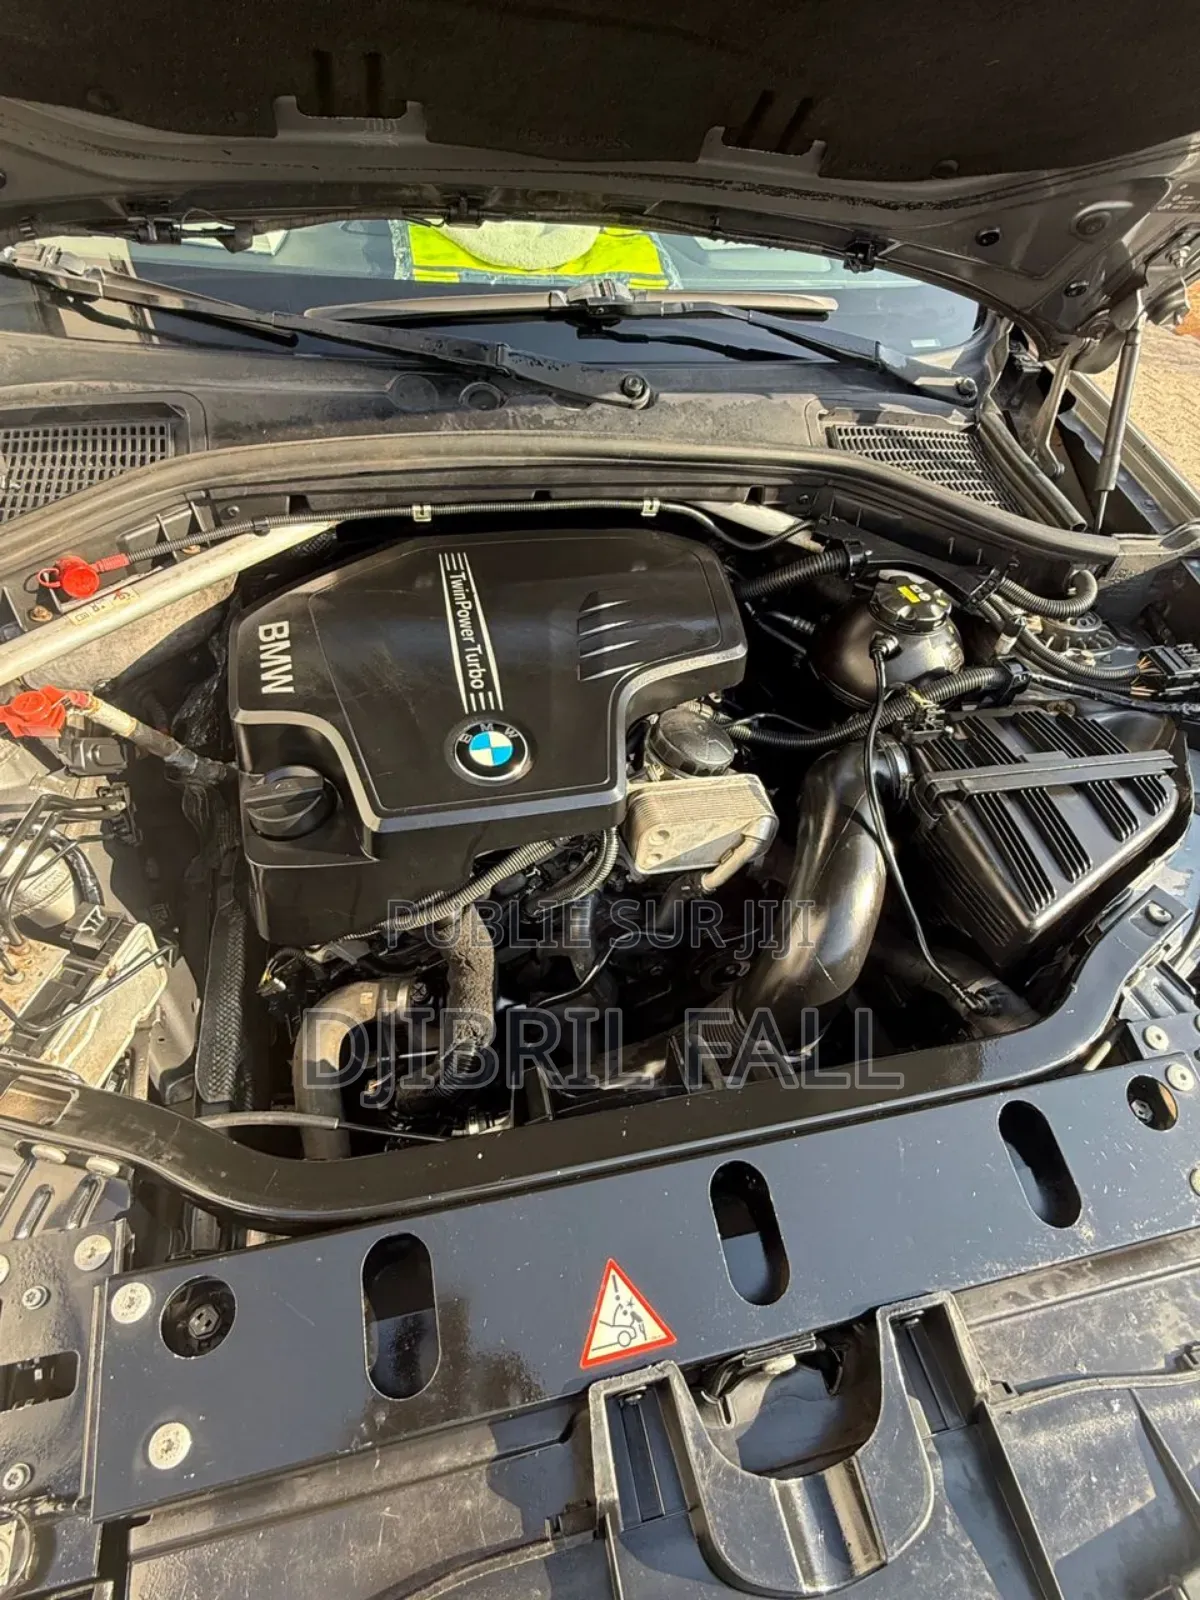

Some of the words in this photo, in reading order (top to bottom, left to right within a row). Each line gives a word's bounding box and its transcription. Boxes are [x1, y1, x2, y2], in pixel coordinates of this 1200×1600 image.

[258, 620, 295, 694] BMW
[449, 571, 476, 643] TwinPower
[464, 643, 487, 690] Turbo
[459, 722, 521, 744] BMW
